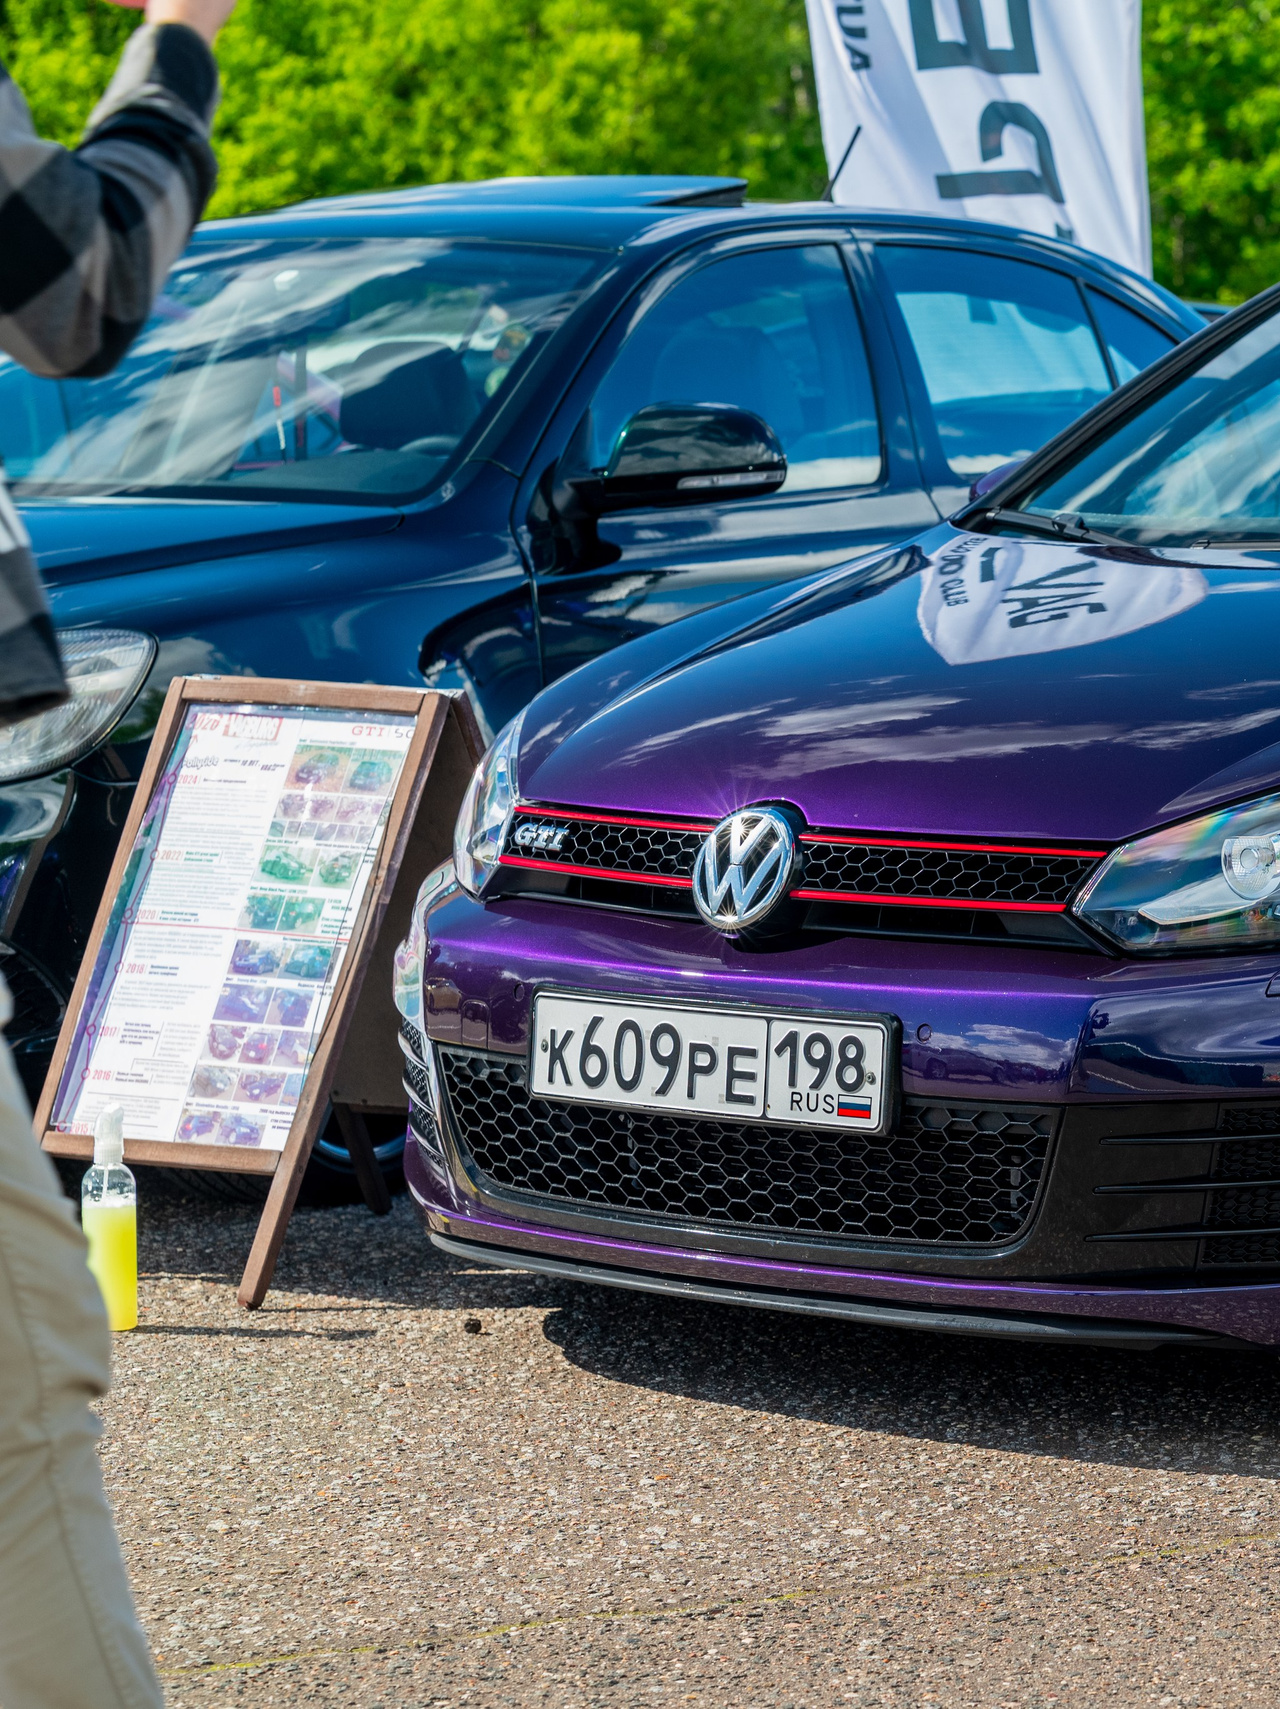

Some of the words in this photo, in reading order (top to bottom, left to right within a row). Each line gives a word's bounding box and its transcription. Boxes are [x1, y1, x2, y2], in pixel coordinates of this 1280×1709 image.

[1000, 560, 1108, 629] VAG
[352, 725, 384, 737] GTI
[177, 774, 199, 785] 2024
[514, 823, 570, 852] GTI
[161, 850, 182, 861] 2022
[774, 1029, 867, 1094] 198
[92, 1070, 112, 1081] 2016
[790, 1091, 835, 1115] RUS
[70, 1122, 88, 1135] 2015
